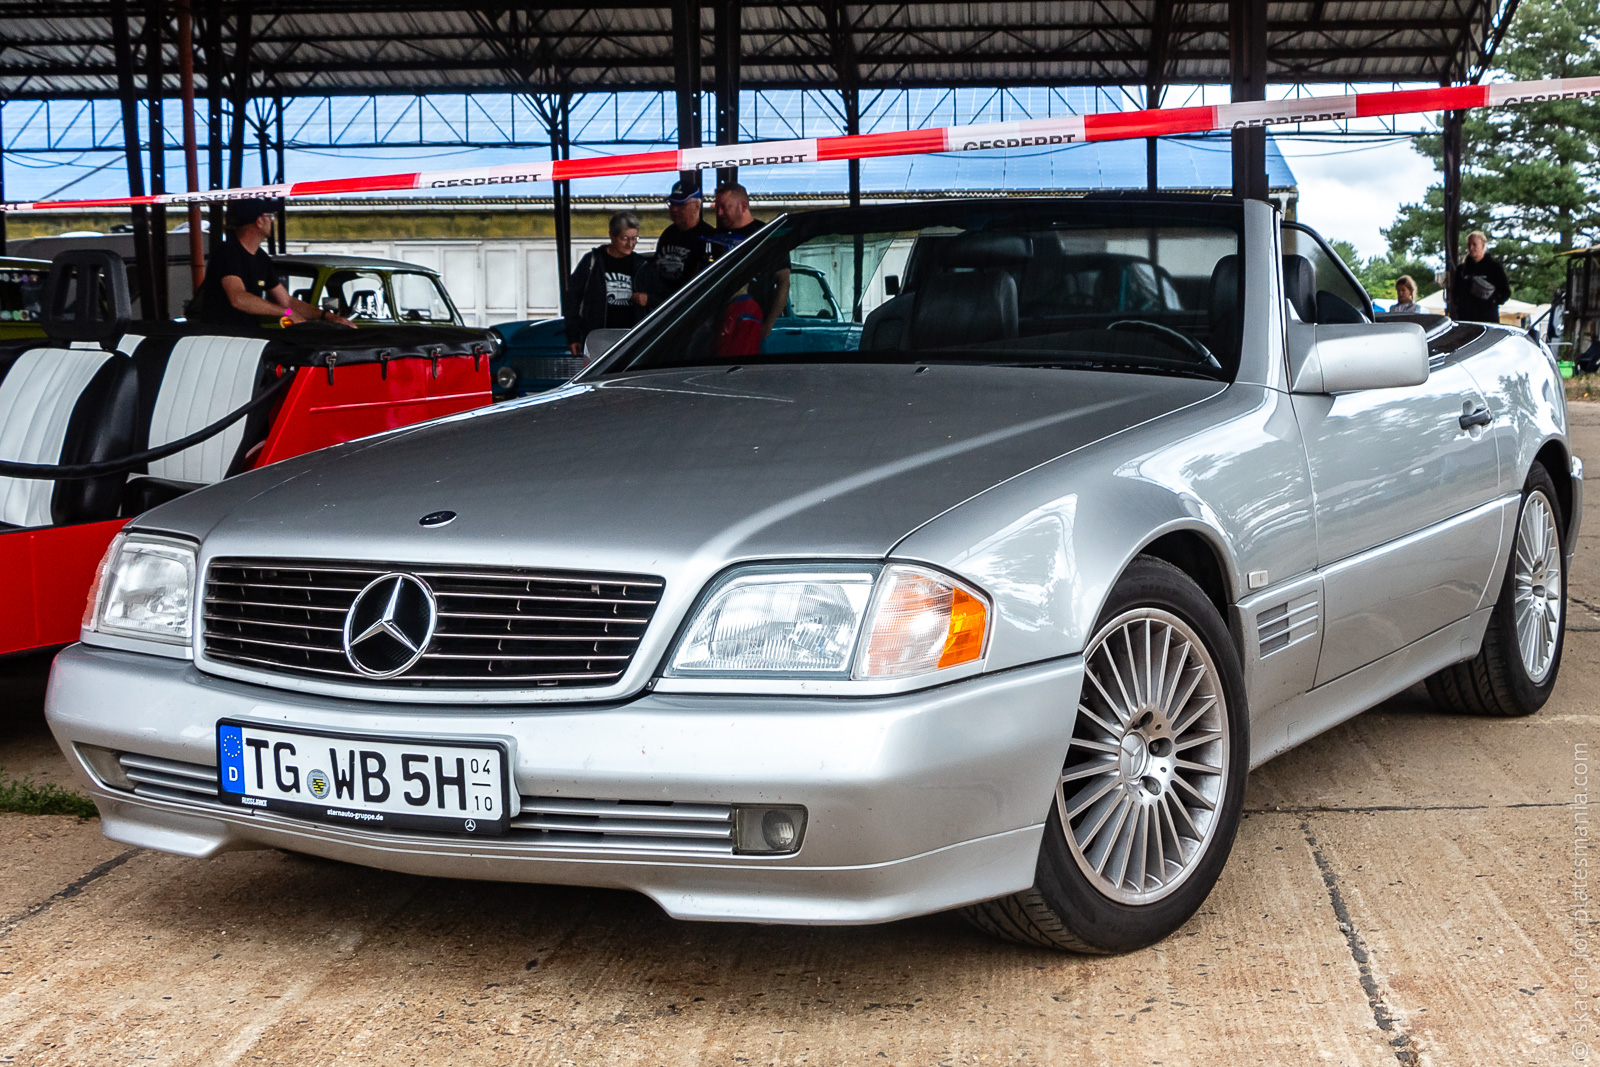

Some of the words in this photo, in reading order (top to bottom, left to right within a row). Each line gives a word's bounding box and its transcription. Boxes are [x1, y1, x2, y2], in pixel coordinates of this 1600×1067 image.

[228, 766, 239, 782] D
[245, 737, 301, 793] TG
[329, 748, 391, 803] WB
[401, 753, 467, 811] 5H
[470, 758, 491, 775] 04
[475, 795, 493, 812] 10
